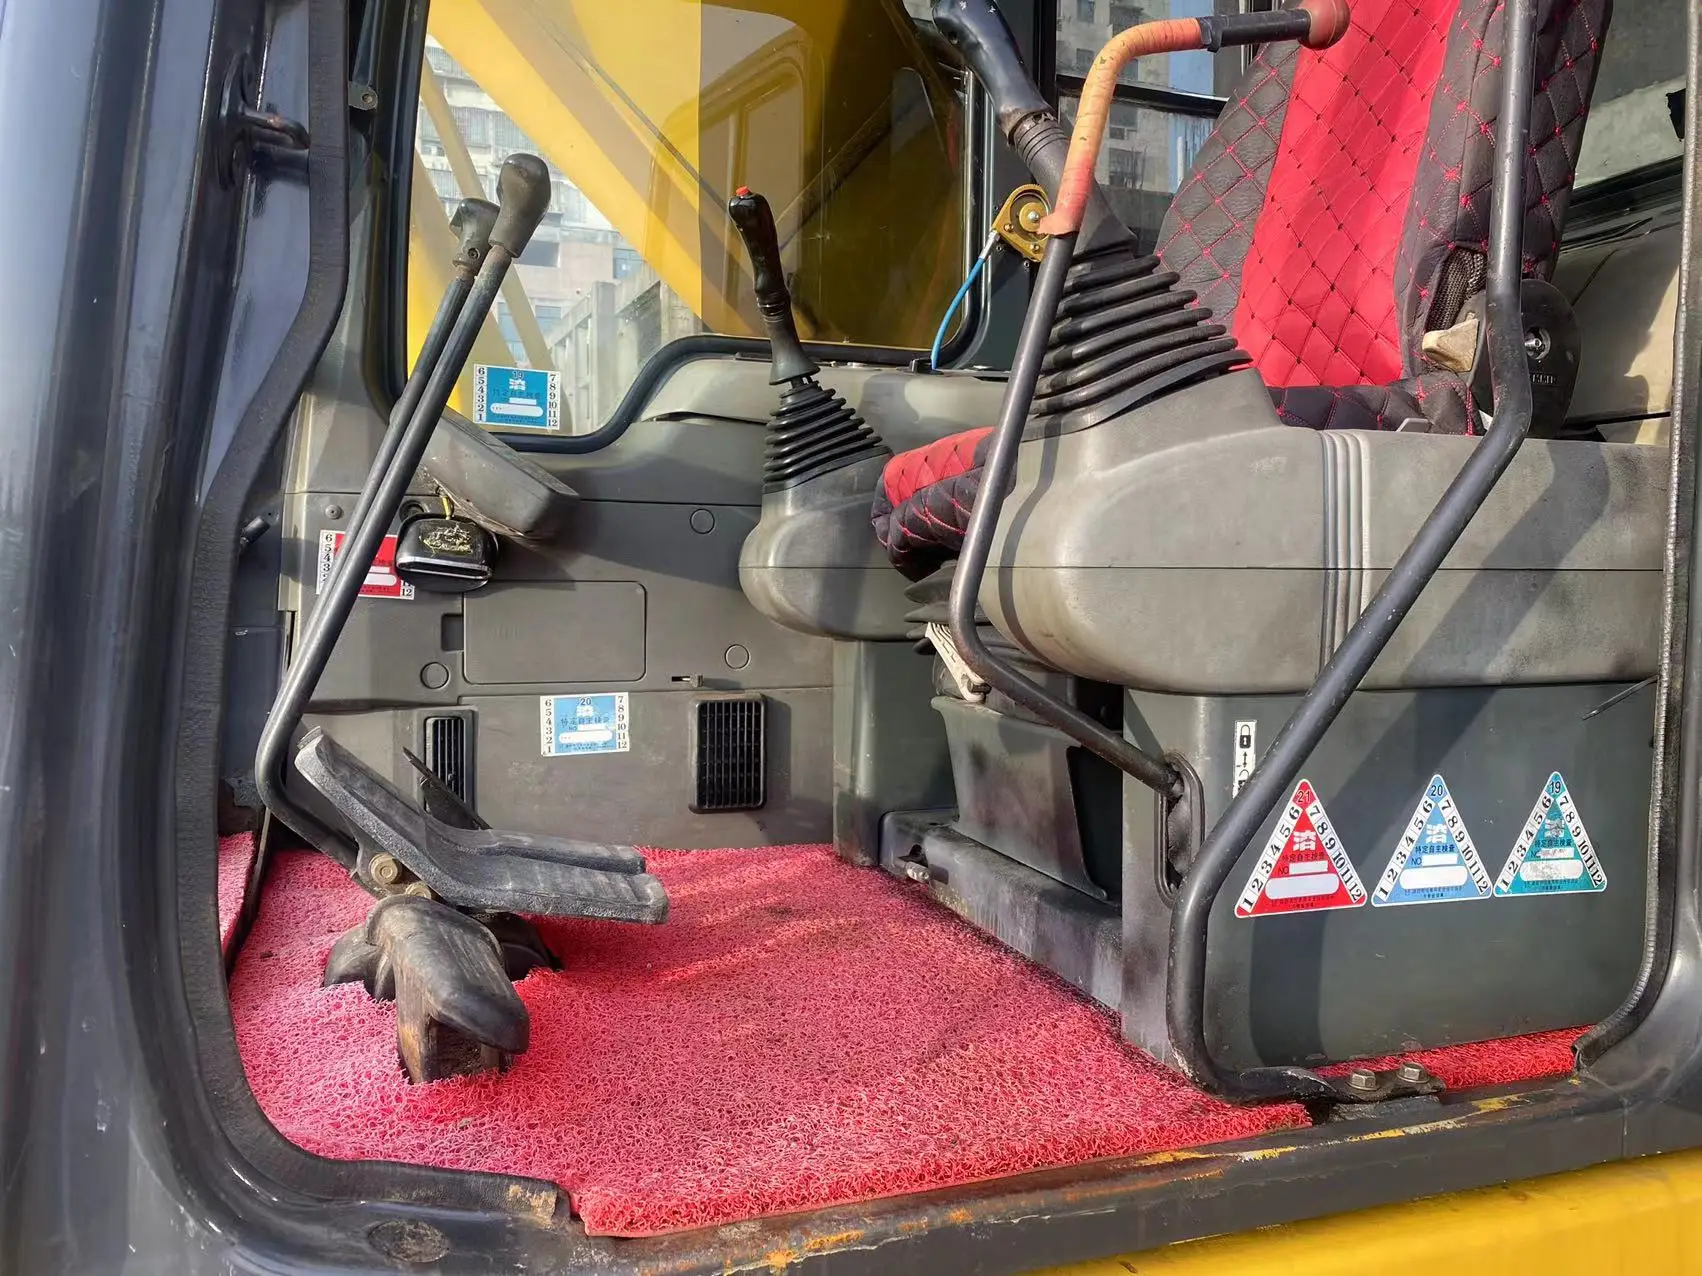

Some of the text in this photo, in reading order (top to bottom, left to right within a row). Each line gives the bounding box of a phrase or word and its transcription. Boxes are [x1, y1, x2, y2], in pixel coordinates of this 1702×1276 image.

[478, 367, 485, 375] 6
[478, 377, 485, 385] 5
[549, 383, 556, 391] 8
[477, 404, 484, 412] 2
[478, 413, 483, 421] 1
[548, 419, 558, 427] 12
[325, 533, 333, 542] 6
[324, 544, 332, 552] 5
[323, 553, 331, 561] 4
[402, 588, 412, 597] 12
[545, 699, 552, 707] 6
[580, 697, 592, 706] 20
[545, 708, 552, 716] 5
[546, 727, 552, 735] 3
[618, 723, 627, 731] 10
[546, 736, 552, 744] 2
[618, 741, 627, 749] 12
[1430, 784, 1443, 796] 20
[1550, 781, 1561, 793] 19
[1297, 790, 1311, 803] 21
[1501, 796, 1552, 890] 1 2 3 4 5 6
[1559, 796, 1603, 886] 7 8 9 10 11 12
[1378, 800, 1433, 897] 1 2 3 4 5 6
[1441, 800, 1489, 892] 7 8 9 10 11 12
[1309, 805, 1362, 901] 7 8 9 10 11 12
[1243, 806, 1300, 910] 1 2 3 4 5 6
